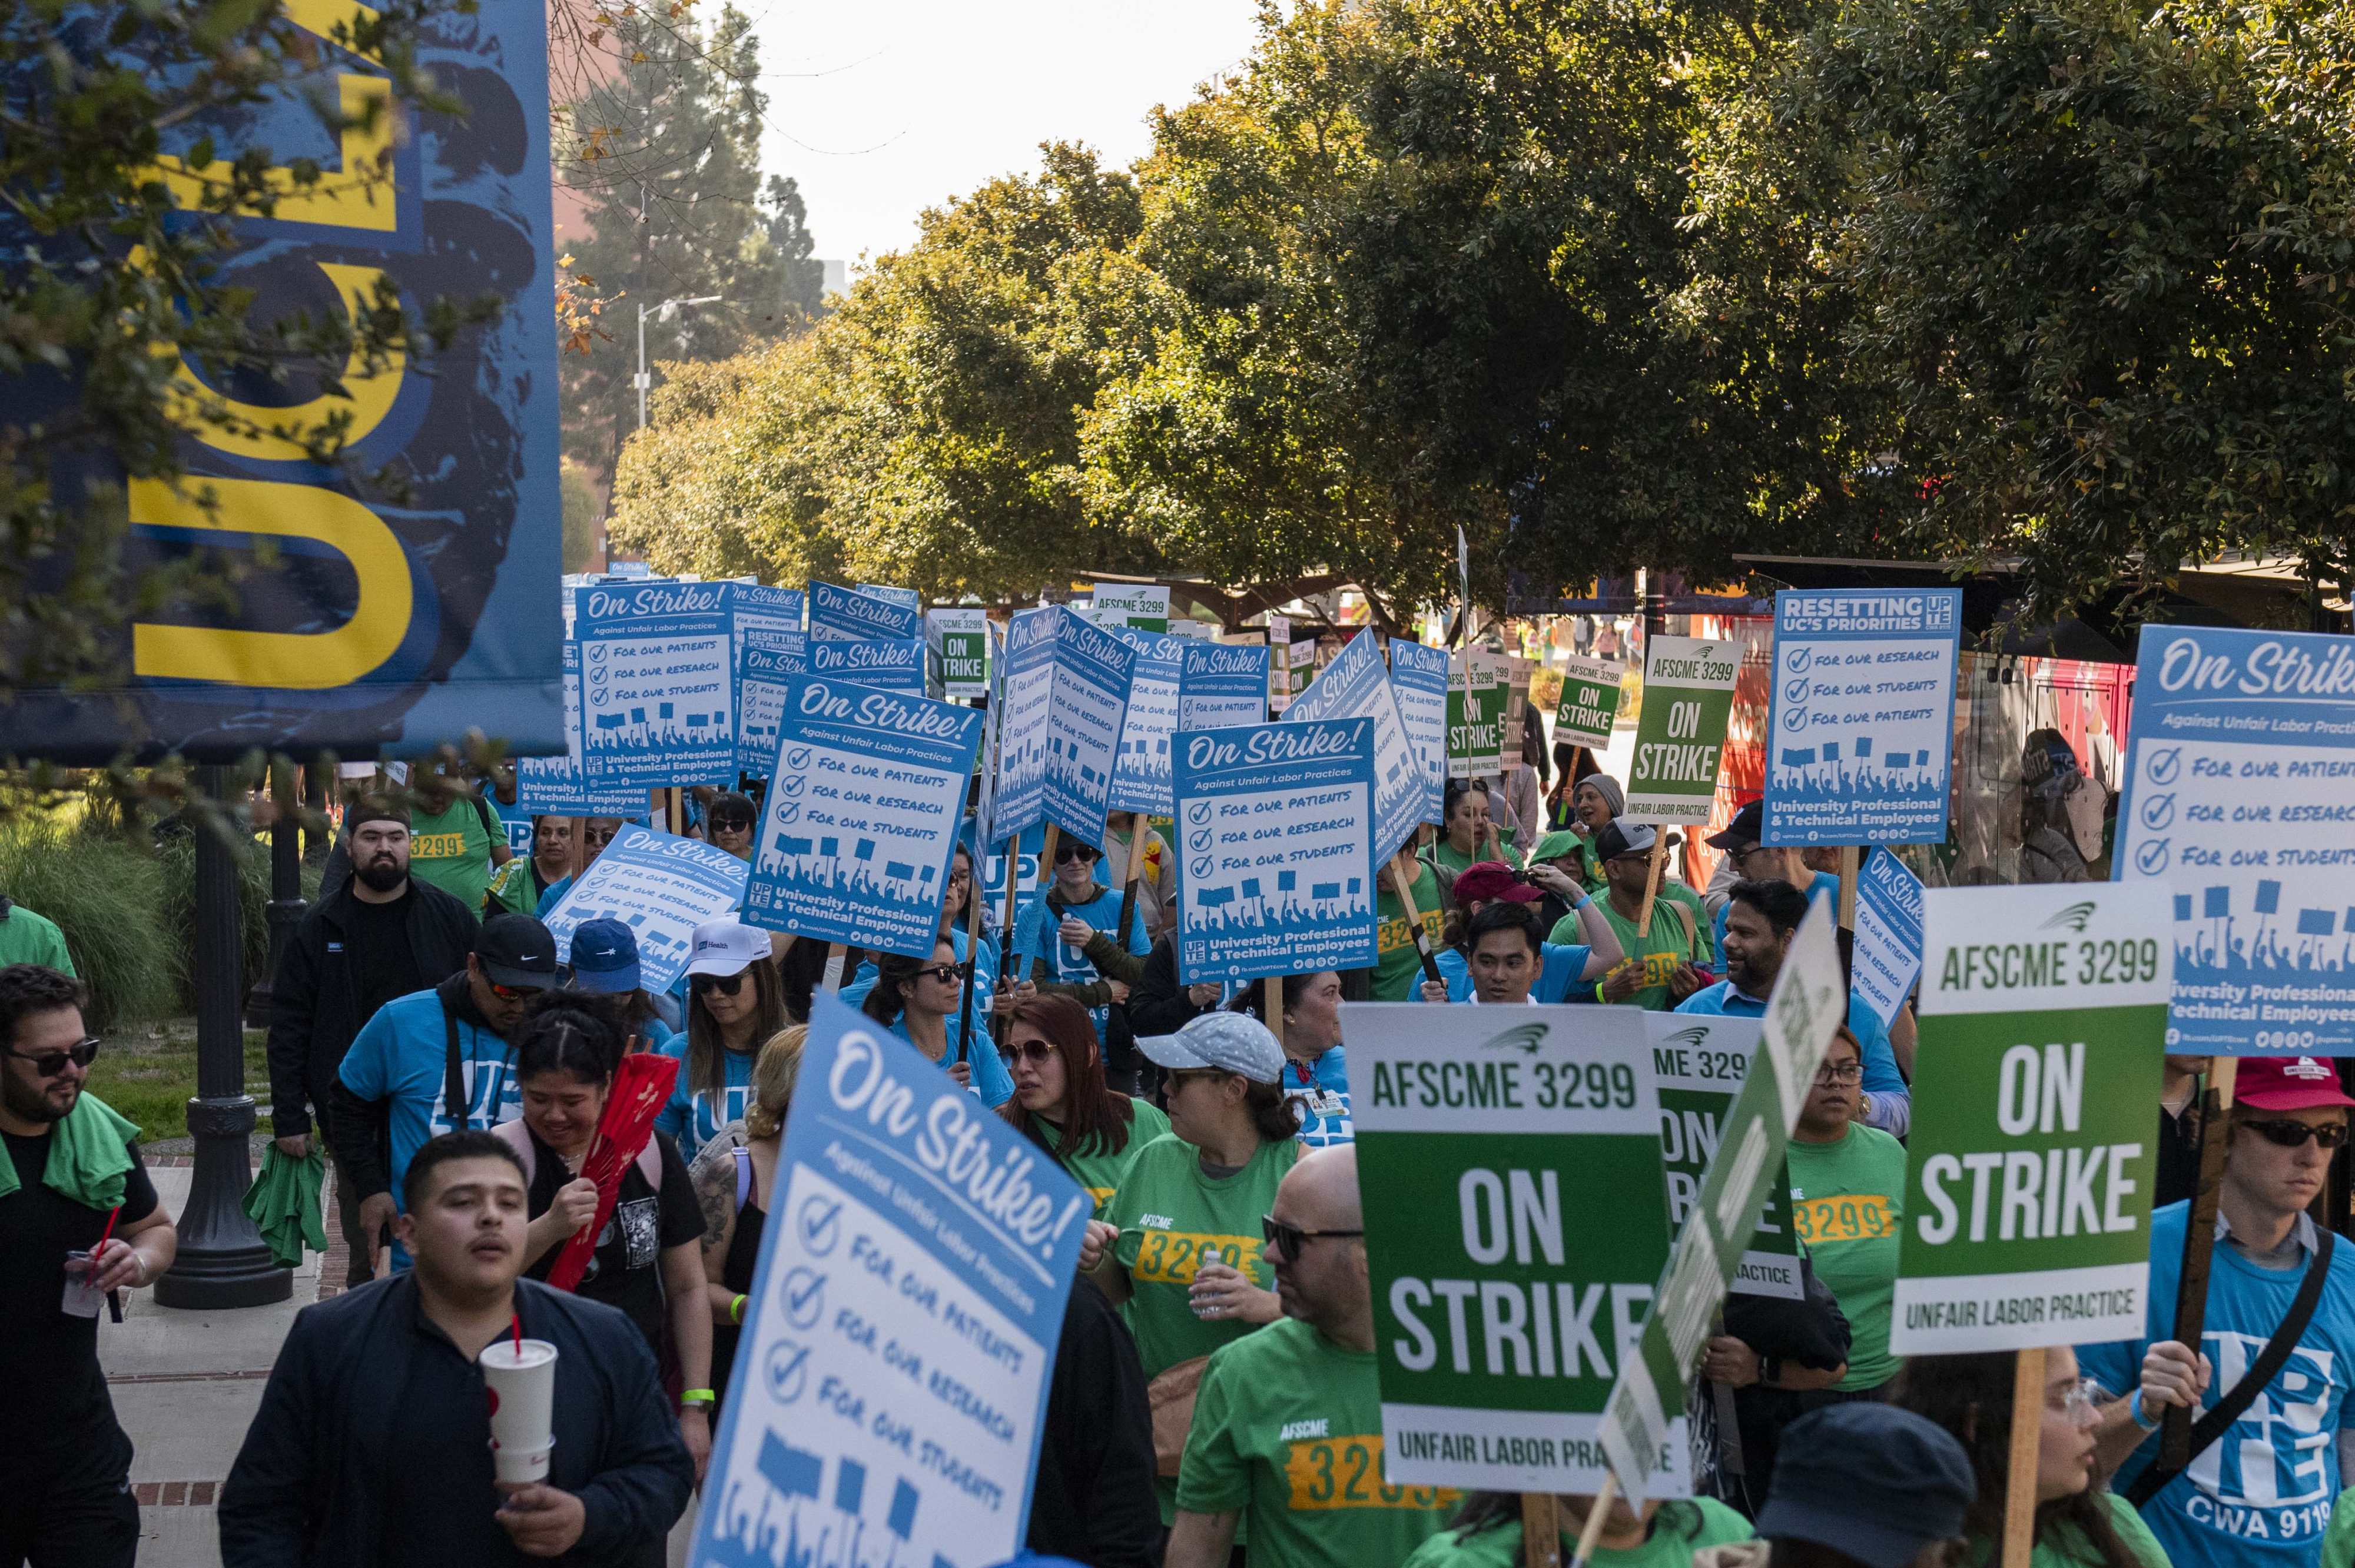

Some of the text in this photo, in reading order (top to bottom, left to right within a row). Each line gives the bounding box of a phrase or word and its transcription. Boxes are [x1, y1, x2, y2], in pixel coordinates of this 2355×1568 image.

[589, 584, 726, 618] On Strike!
[749, 587, 801, 606] Strike!
[861, 587, 915, 602] On Strike!
[817, 587, 913, 630] On Strike!
[1139, 600, 1164, 613] 3299
[1785, 597, 1922, 617] RESETTING
[593, 627, 625, 635] Against
[655, 623, 677, 632] Labor
[819, 613, 875, 636] Against Unfair Labor
[964, 619, 982, 629] 3299
[1783, 617, 1922, 631] UC'S PRIORITIES
[613, 640, 717, 657] FOR OUR PATIENTS
[748, 631, 805, 645] RESETTING
[766, 642, 805, 652] PRIORITIES
[948, 638, 967, 656] ON
[815, 642, 920, 669] On Strike!
[1077, 628, 1133, 673] Strike!
[1187, 648, 1266, 674] On Strike!
[1397, 644, 1447, 674] On Strike!
[1815, 650, 1939, 666] FOR OUR RESEARCH
[943, 658, 981, 676] TRIKE
[1570, 665, 1620, 682] AFSCME 3299
[1653, 659, 1734, 681] AFSCME 3299
[2159, 637, 2235, 691] On
[1476, 672, 1494, 684] 3299
[1059, 674, 1117, 710] FOR OUR PATIENTS
[1579, 686, 1600, 707] ON
[800, 683, 976, 740] On Strike!
[1225, 702, 1256, 711] PATIENTS
[1560, 703, 1611, 730] STRIKE
[1667, 701, 1701, 738] ON
[2161, 713, 2311, 732] Against Unfair Labor
[800, 727, 953, 763] Against Unfair Labor Practices
[1188, 721, 1365, 769] On Strike!
[1451, 724, 1497, 750] STRIKE
[1554, 730, 1606, 746] UNFAIR LABOR PRACTICE
[606, 749, 732, 765] University Professional
[617, 763, 670, 773] Technical
[673, 759, 732, 771] Employees
[1636, 743, 1717, 782] STRIKE
[2192, 757, 2278, 777] FOR OUR
[818, 758, 948, 788] FOR OUR PATIENTS
[1194, 768, 1352, 790] Against Unfair Labor Practices
[812, 785, 943, 815] FOR OUR RESEARCH
[1628, 803, 1708, 816] UNFAIR LABOR PRACTICE
[1772, 798, 1941, 813] University Professional
[807, 810, 938, 841] FOR OUR STUDENTS
[1771, 813, 1940, 828] & Technical Employees
[411, 836, 459, 856] 3299
[623, 832, 751, 881] On Strike!
[775, 887, 933, 926] University Professional
[773, 899, 930, 938] & Technical Employees
[761, 916, 784, 925] upte.org
[895, 942, 924, 951] @uptecwa
[1210, 925, 1370, 949] University Professional
[1210, 939, 1370, 961] & Technical Employees
[1241, 964, 1288, 972] fb.com/UPTEcwa
[1339, 955, 1368, 964] @uptecwa
[1941, 939, 2158, 991] AFSCME 3299
[1372, 1061, 1636, 1109] AFSCME 3299
[1998, 1042, 2086, 1137] ON
[828, 1030, 1082, 1259] On Strike!
[1918, 1143, 2143, 1245] STRIKE
[1139, 1213, 1173, 1230] AFSCME
[1459, 1168, 1565, 1267] ON
[1794, 1202, 1885, 1239] 3299
[1907, 1289, 2135, 1330] UNFAIR LABOR PRACTICE
[1280, 1419, 1329, 1441] AFSCME
[1397, 1430, 1555, 1466] UNFAIR LABOR
[2185, 1496, 2269, 1539] CWA
